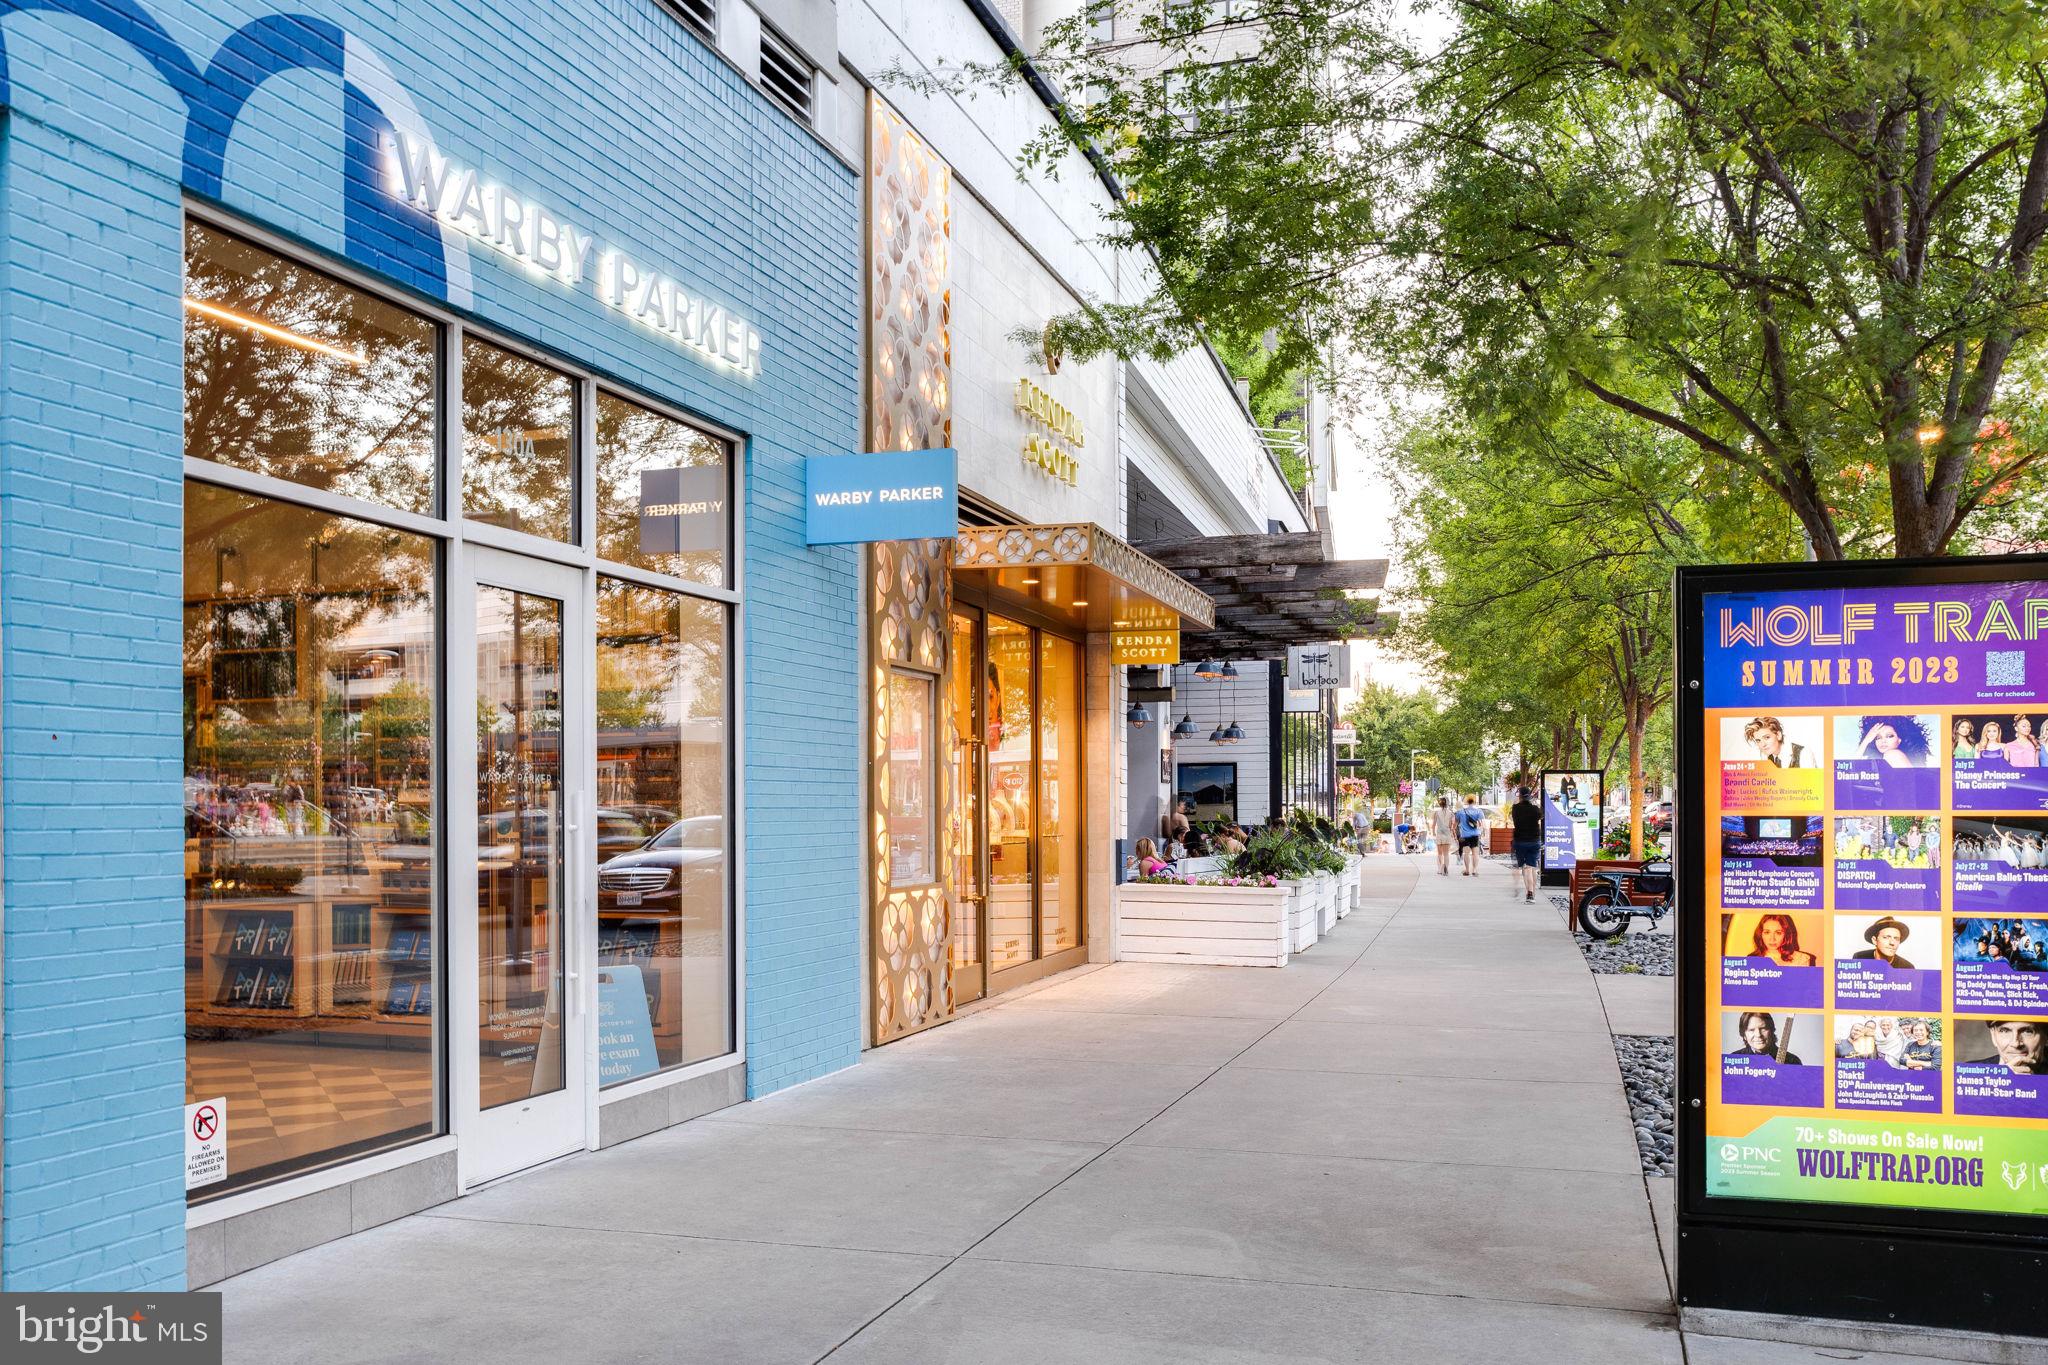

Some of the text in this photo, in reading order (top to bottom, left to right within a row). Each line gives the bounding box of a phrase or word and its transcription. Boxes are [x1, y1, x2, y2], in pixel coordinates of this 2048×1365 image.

[394, 130, 763, 376] WARBY PARKER
[1014, 378, 1085, 448] KENDRA
[1023, 433, 1079, 487] SCOTT
[815, 486, 944, 506] WARBY PARKER
[1720, 598, 2048, 648] WOLF TRAP
[1116, 635, 1172, 646] KENDRA
[1121, 647, 1167, 658] SCOTT
[1742, 656, 1959, 687] SUMMER 2023
[1302, 672, 1339, 686] bartaco
[1837, 762, 1849, 770] July
[1954, 761, 1975, 770] July 12
[516, 773, 552, 784] PARKER
[1837, 771, 1880, 780] Diana Ross
[1955, 770, 2020, 781] Disney Princess
[1724, 778, 1777, 786] Brandi Carlile
[1955, 781, 2007, 789] The Concert
[1546, 836, 1572, 844] Delivery
[1724, 861, 1735, 869] July
[1837, 862, 1849, 870] July
[1955, 863, 1968, 871] July
[1758, 870, 1789, 878] Symphonic
[1837, 871, 1876, 880] DISPATCH
[1955, 872, 2022, 882] American Ballet
[1724, 877, 1820, 887] Music from Studio Ghibli
[1863, 882, 1894, 890] Symphony
[1955, 882, 1983, 891] Giselle
[1724, 887, 1815, 897] Films of Hayao Miyazaki
[1749, 897, 1779, 905] Symphony
[1837, 961, 1857, 970] August
[1956, 964, 1976, 973] August
[1724, 968, 1782, 978] Regina Spektor
[1837, 971, 1884, 980] Jason Mraz
[1837, 981, 1912, 991] and His Superband
[1956, 981, 1966, 989] Big
[1967, 981, 1987, 989] Daddy
[2005, 982, 2021, 990] Doug
[2023, 991, 2039, 999] Rick,
[2013, 999, 2022, 1007] DJ
[620, 1033, 634, 1043] an
[608, 1048, 641, 1060] exam
[1724, 1057, 1743, 1065] August
[1837, 1061, 1857, 1070] August
[600, 1062, 633, 1077] today
[1724, 1066, 1776, 1078] John Fogerty
[1956, 1066, 1986, 1074] September
[1837, 1070, 1865, 1080] Shakti
[1838, 1080, 1925, 1092] 50th Anniversary Tour
[1956, 1075, 2012, 1087] James Taylor
[1838, 1090, 1853, 1098] John
[1853, 1090, 1887, 1100] McLaughlin
[1893, 1092, 1910, 1100] Zakir
[1956, 1087, 2037, 1099] & His All-Star Band
[1794, 1126, 1984, 1152] 70+ Shows On Sale Now!
[201, 1144, 211, 1152] NO
[191, 1149, 221, 1163] FIREARMS
[1741, 1146, 1781, 1162] PNC
[187, 1156, 225, 1171] ALLOWED ON
[1796, 1148, 1984, 1188] WOLFTRAP.ORG
[191, 1165, 221, 1178] PREMISES
